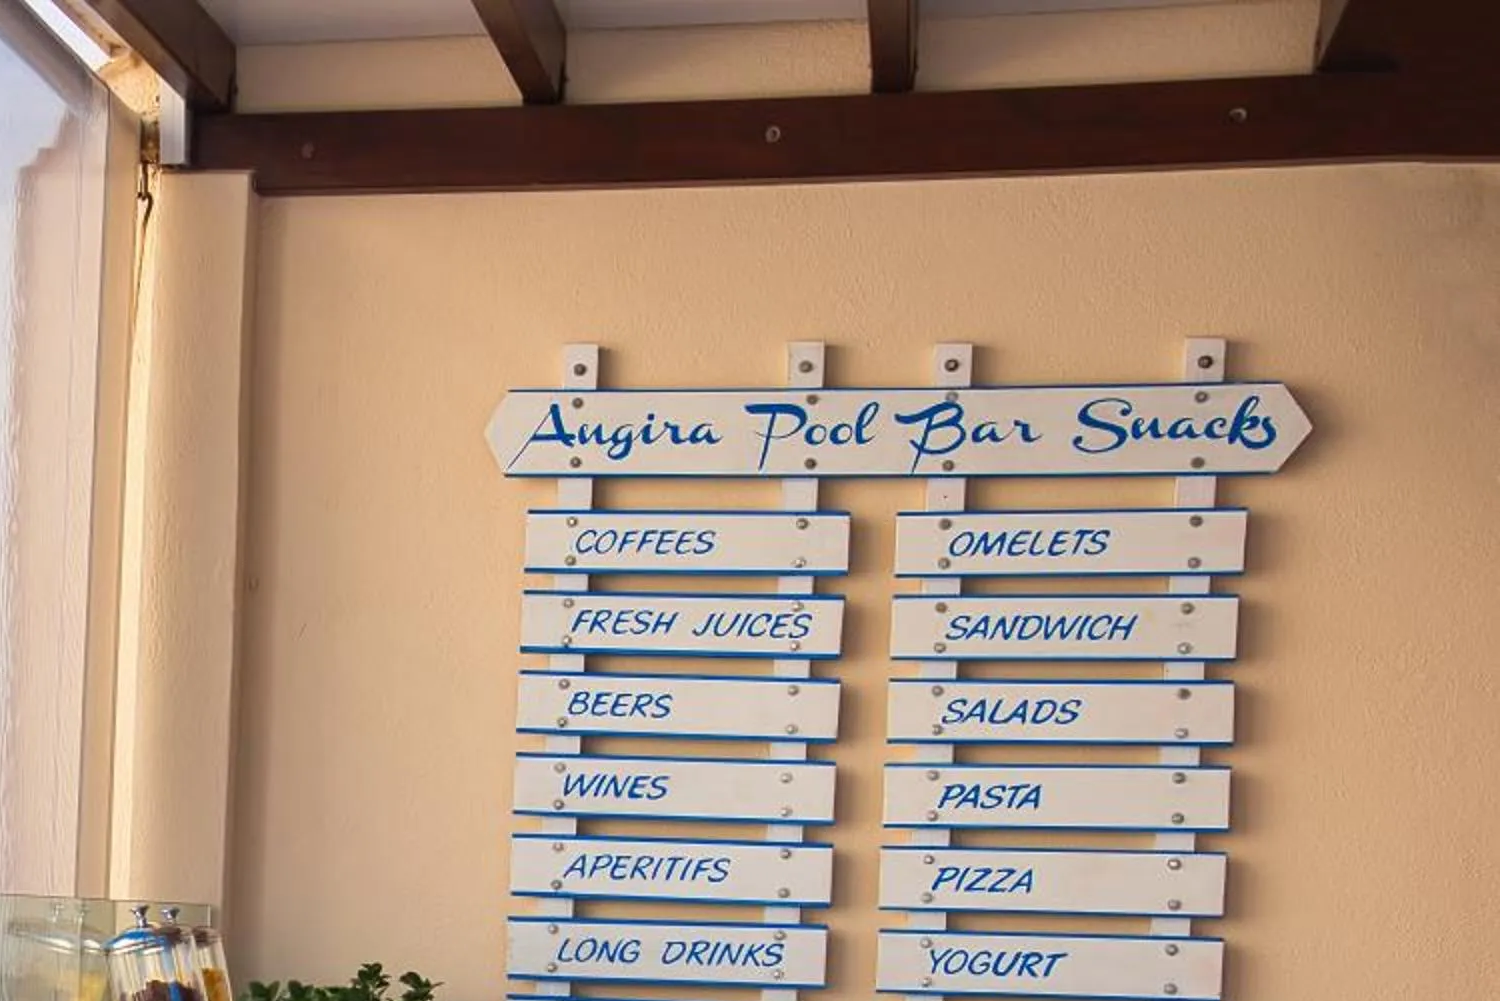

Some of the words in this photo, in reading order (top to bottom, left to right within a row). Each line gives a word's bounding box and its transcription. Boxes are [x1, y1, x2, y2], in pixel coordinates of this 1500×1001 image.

[743, 402, 880, 471] Pool
[893, 399, 1044, 472] Bar
[1072, 395, 1277, 452] Snacks
[575, 528, 715, 556] COFFEES
[947, 527, 1108, 558] OMELETS
[571, 607, 677, 636] FRESH
[692, 611, 812, 641] JUICES
[945, 612, 1137, 642] SANDWICH
[566, 690, 673, 720] BEERS
[941, 697, 1083, 729] SALADS
[563, 771, 671, 802] WINES
[938, 782, 1043, 810] PASTA
[563, 853, 727, 885] APERITIFS
[931, 865, 1036, 895] PIZZA
[555, 935, 641, 966] LONG
[661, 935, 785, 968] DRINKS
[928, 948, 1065, 979] YOGURT
